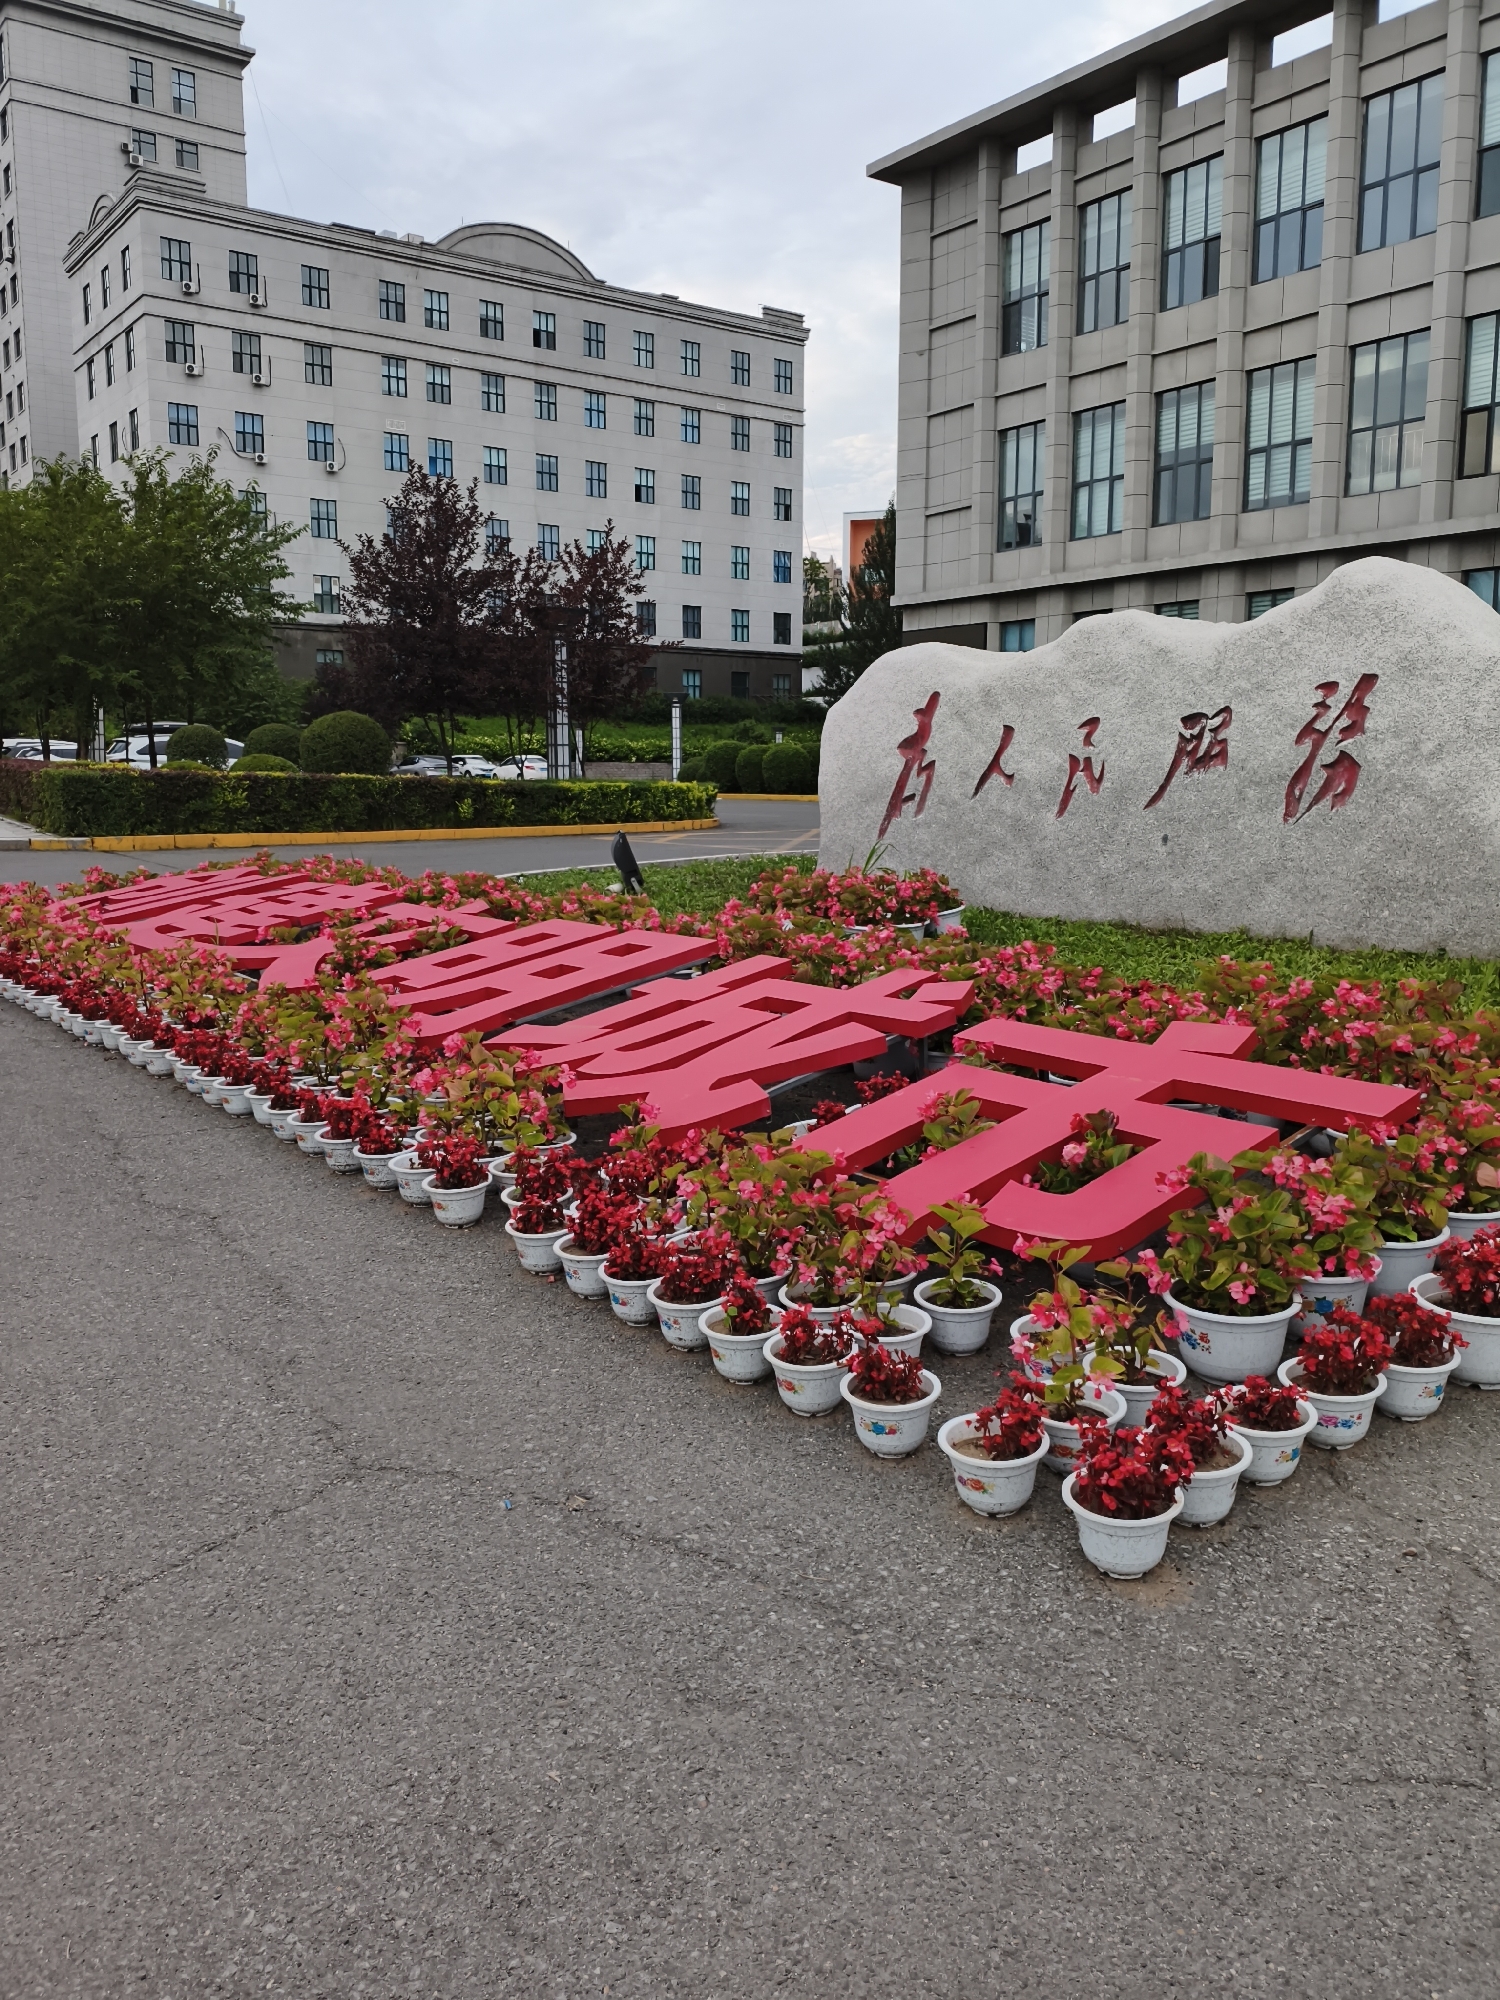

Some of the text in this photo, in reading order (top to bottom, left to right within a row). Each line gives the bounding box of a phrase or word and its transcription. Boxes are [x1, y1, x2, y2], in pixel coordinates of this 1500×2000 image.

[42, 866, 1422, 1263] 创建文明城市
